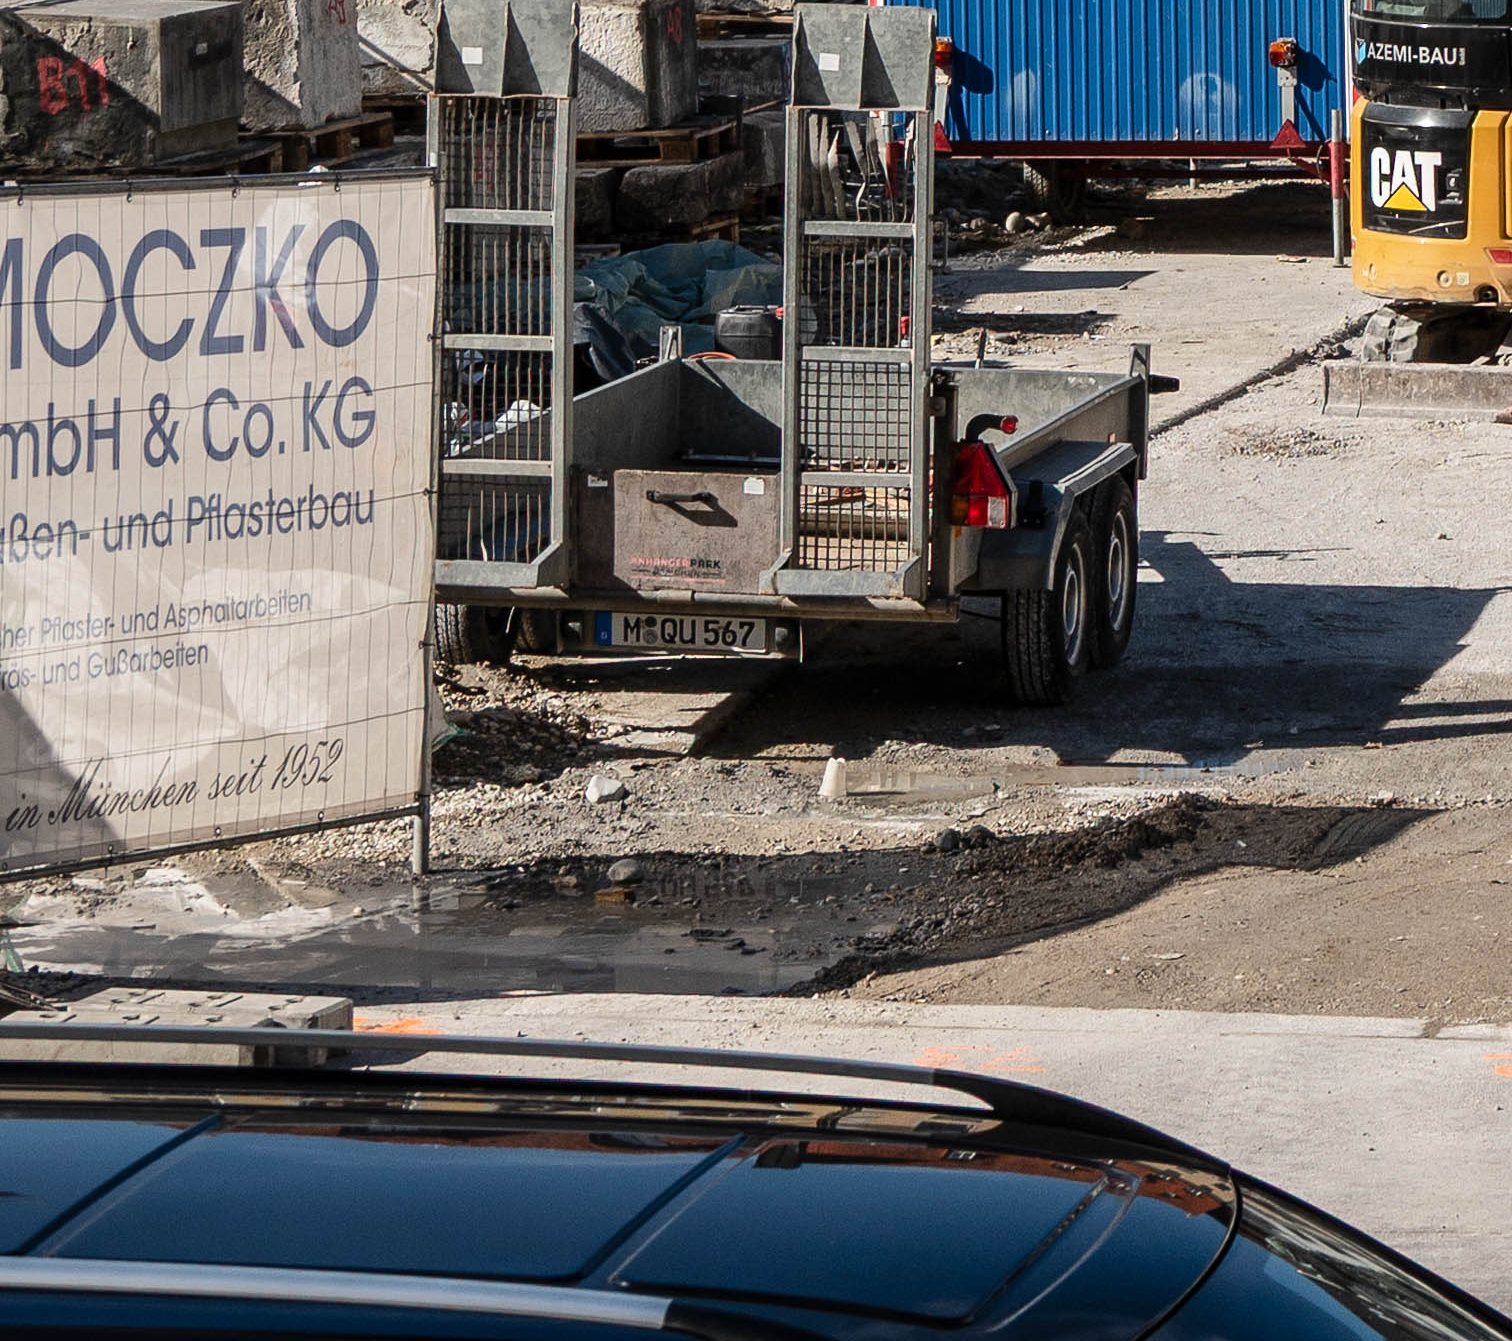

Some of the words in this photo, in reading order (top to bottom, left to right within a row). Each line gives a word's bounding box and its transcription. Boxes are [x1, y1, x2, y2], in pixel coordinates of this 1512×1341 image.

[1367, 42, 1457, 66] AZEMI-BAU
[1370, 147, 1443, 212] CAT
[143, 392, 181, 468] &
[201, 387, 287, 462] Co.
[302, 375, 377, 453] KG
[0, 512, 90, 563] ßen-
[102, 498, 174, 553] und
[185, 483, 375, 544] Pflasterbau
[0, 621, 33, 650] her
[40, 612, 115, 645] Pflaster-
[121, 605, 159, 634] und
[163, 590, 314, 634] Asphaltarbeiten
[624, 615, 641, 642] M
[660, 617, 697, 644] QU
[703, 619, 756, 647] 567
[42, 657, 81, 685] und
[87, 642, 210, 679] Gußarbeiten
[5, 794, 41, 833] in
[48, 756, 199, 825] München
[207, 754, 268, 801] seit
[270, 738, 345, 791] 1952
